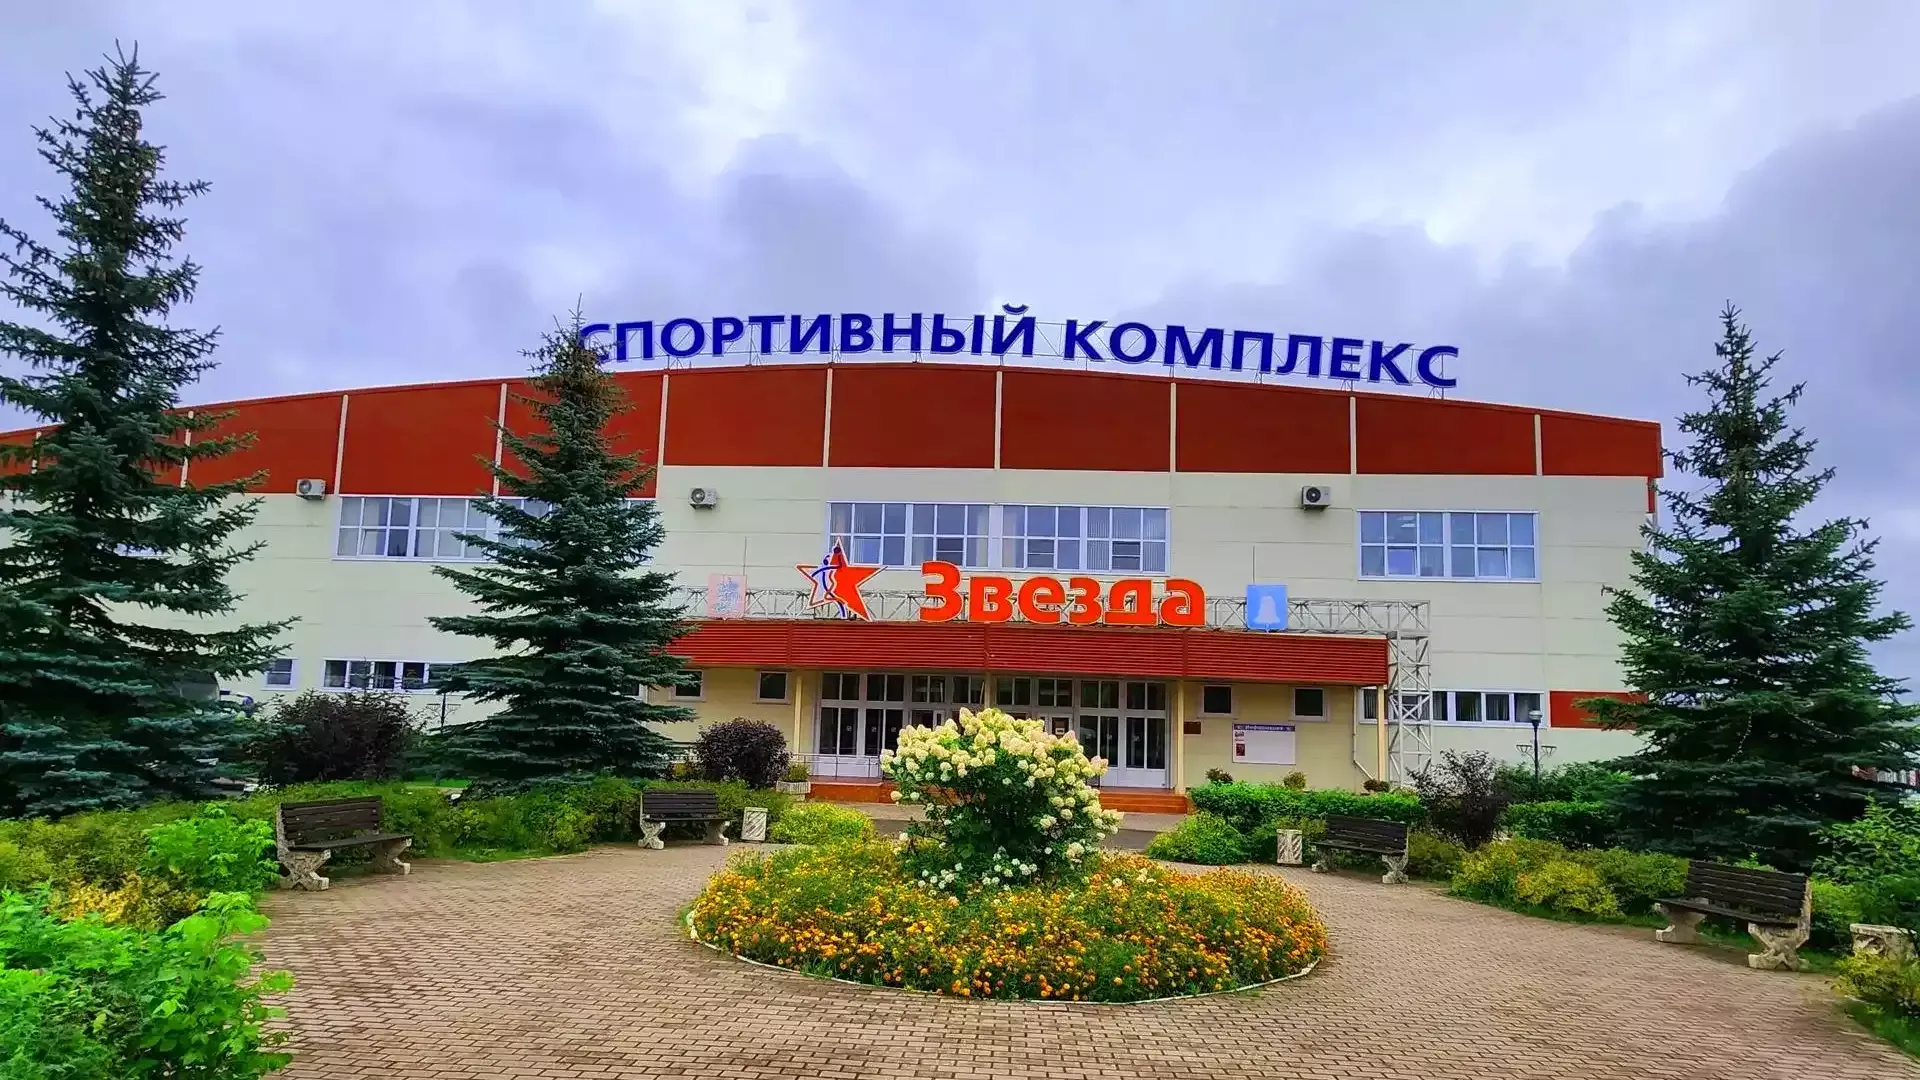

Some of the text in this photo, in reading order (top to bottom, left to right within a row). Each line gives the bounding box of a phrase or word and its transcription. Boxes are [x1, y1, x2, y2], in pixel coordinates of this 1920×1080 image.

[580, 303, 1459, 388] СПОРТИВНЫЙ КОМПЛЕКС
[919, 560, 1207, 626] Звезда
